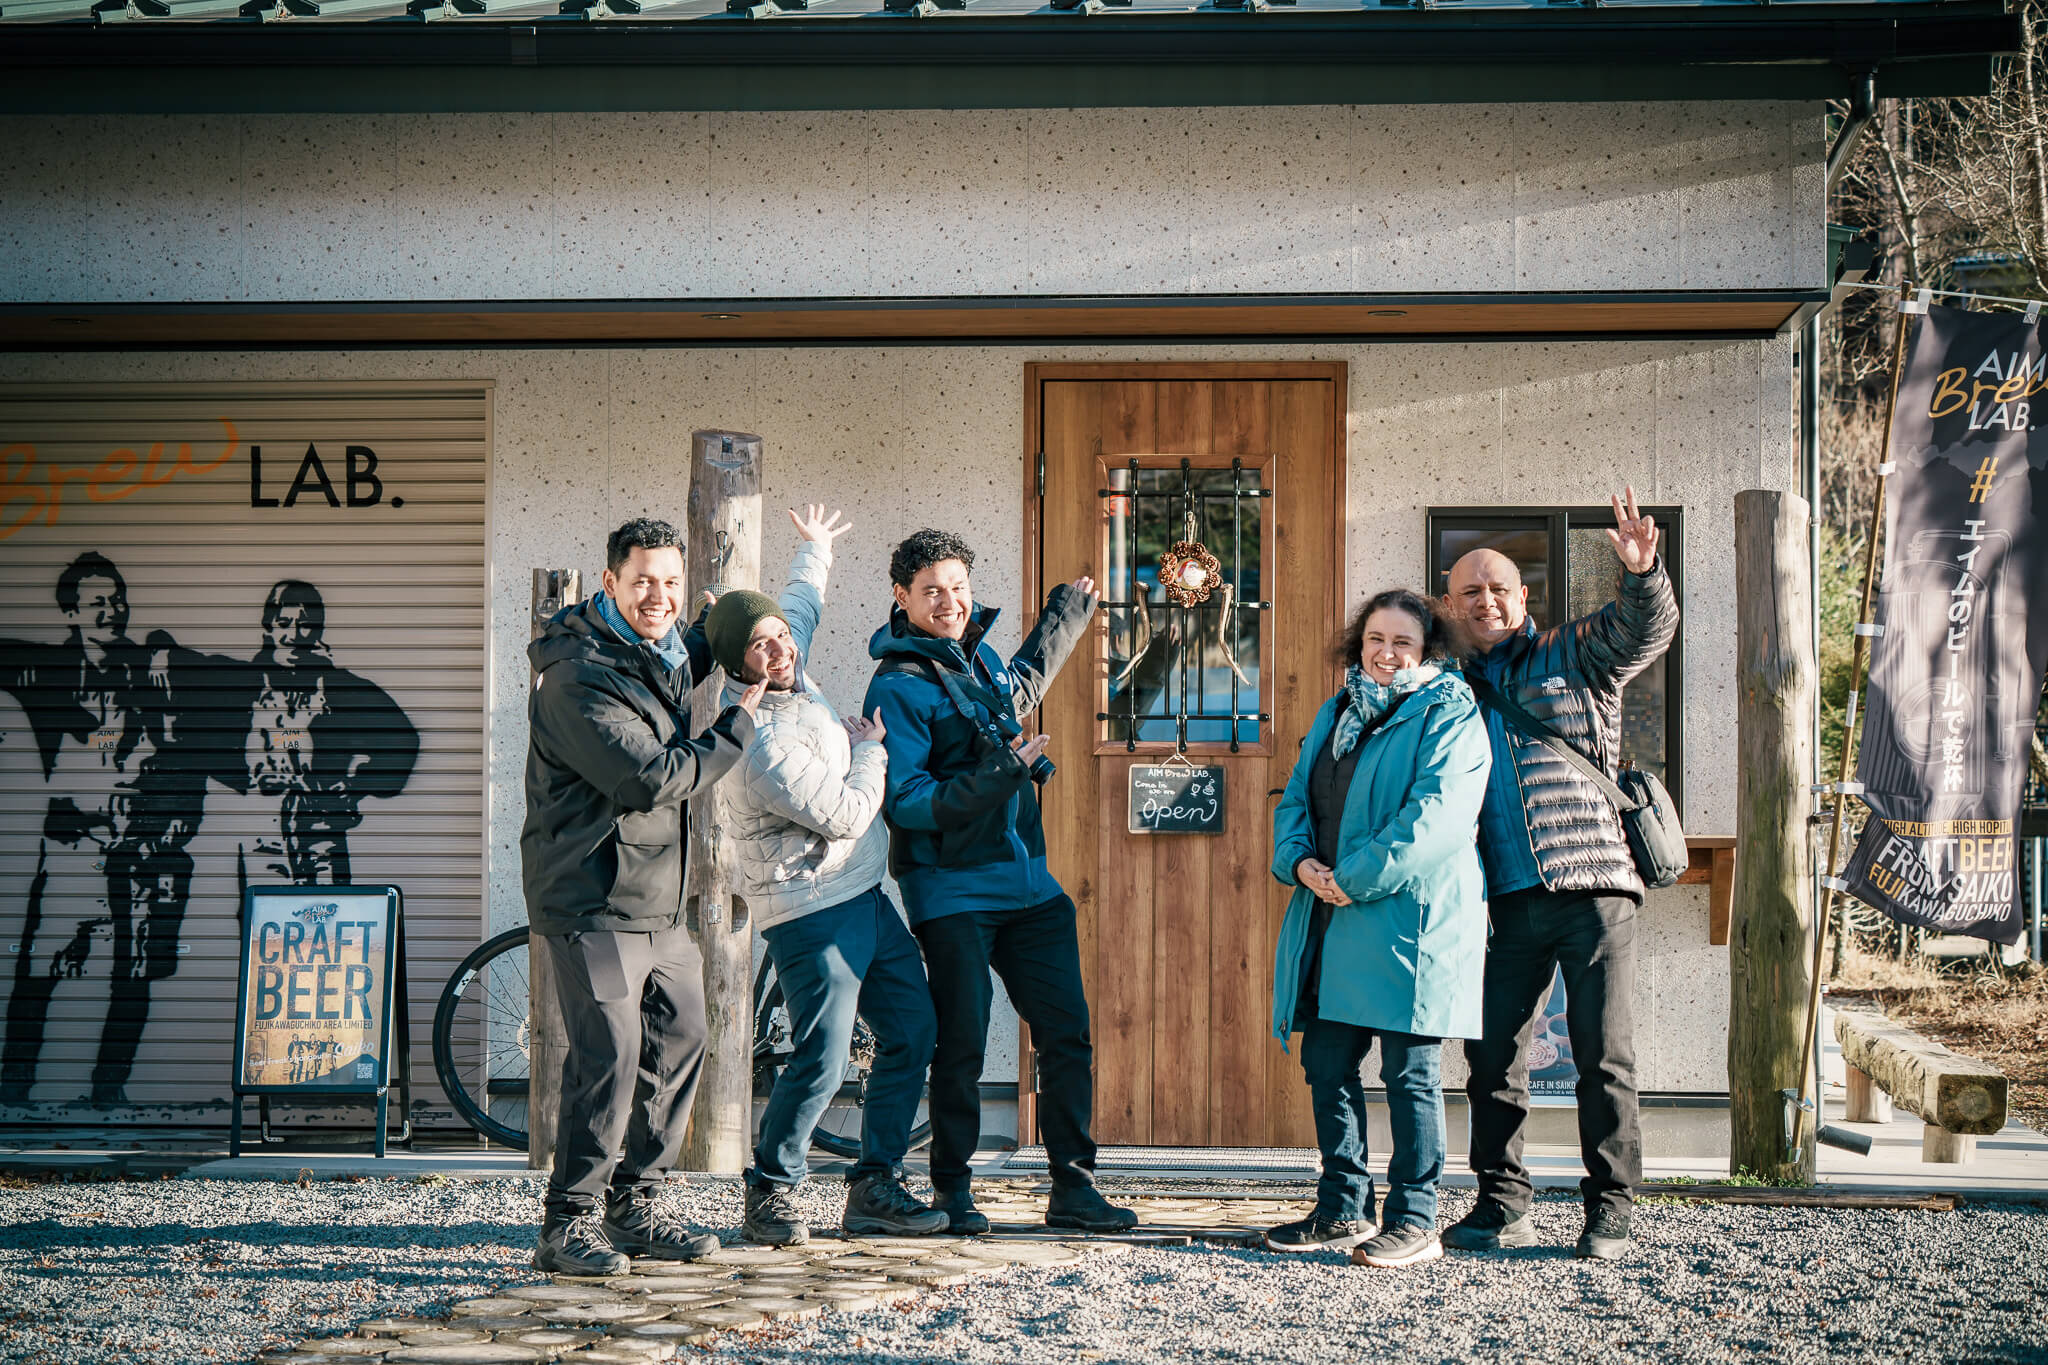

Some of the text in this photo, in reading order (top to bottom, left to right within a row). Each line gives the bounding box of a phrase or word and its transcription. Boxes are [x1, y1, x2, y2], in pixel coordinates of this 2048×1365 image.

[1973, 348, 2047, 382] AIM
[1968, 400, 2036, 431] LAB.
[250, 441, 404, 508] LAB.
[1147, 769, 1164, 777] AIM
[1142, 798, 1217, 829] Open
[1952, 820, 1977, 834] HIGH
[1947, 871, 2013, 903] SAIKO
[259, 921, 377, 963] CRAFT
[255, 965, 373, 1020] BEER
[254, 1020, 374, 1030] FUJIKAWAGUCHIKO AREA LIMITED
[1528, 1080, 1576, 1090] CAFE IN SAIKO
